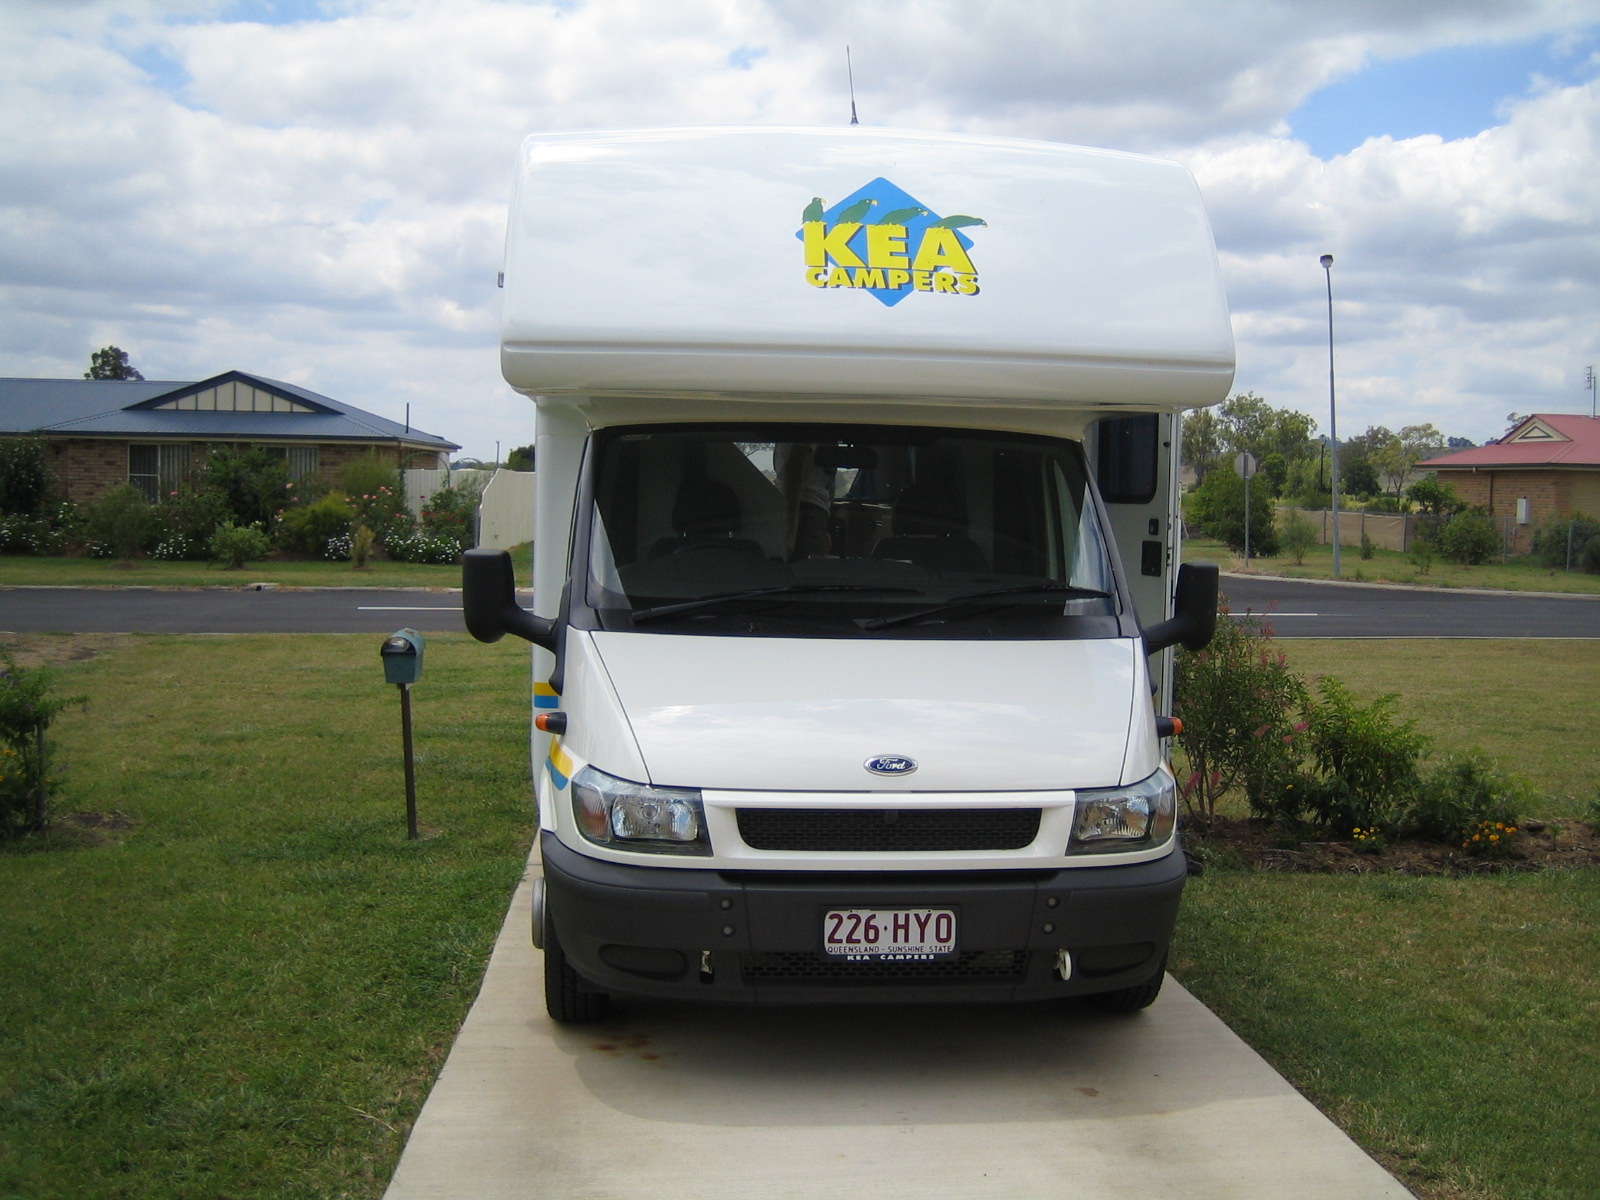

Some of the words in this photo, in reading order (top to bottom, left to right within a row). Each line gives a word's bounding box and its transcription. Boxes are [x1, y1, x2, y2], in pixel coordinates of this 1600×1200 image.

[803, 221, 978, 275] KEA
[804, 266, 980, 296] CAMPERS
[876, 757, 906, 770] Ford
[827, 945, 880, 954] QUEENSLAND
[887, 945, 924, 953] SUNSHINE
[929, 945, 952, 953] STATE
